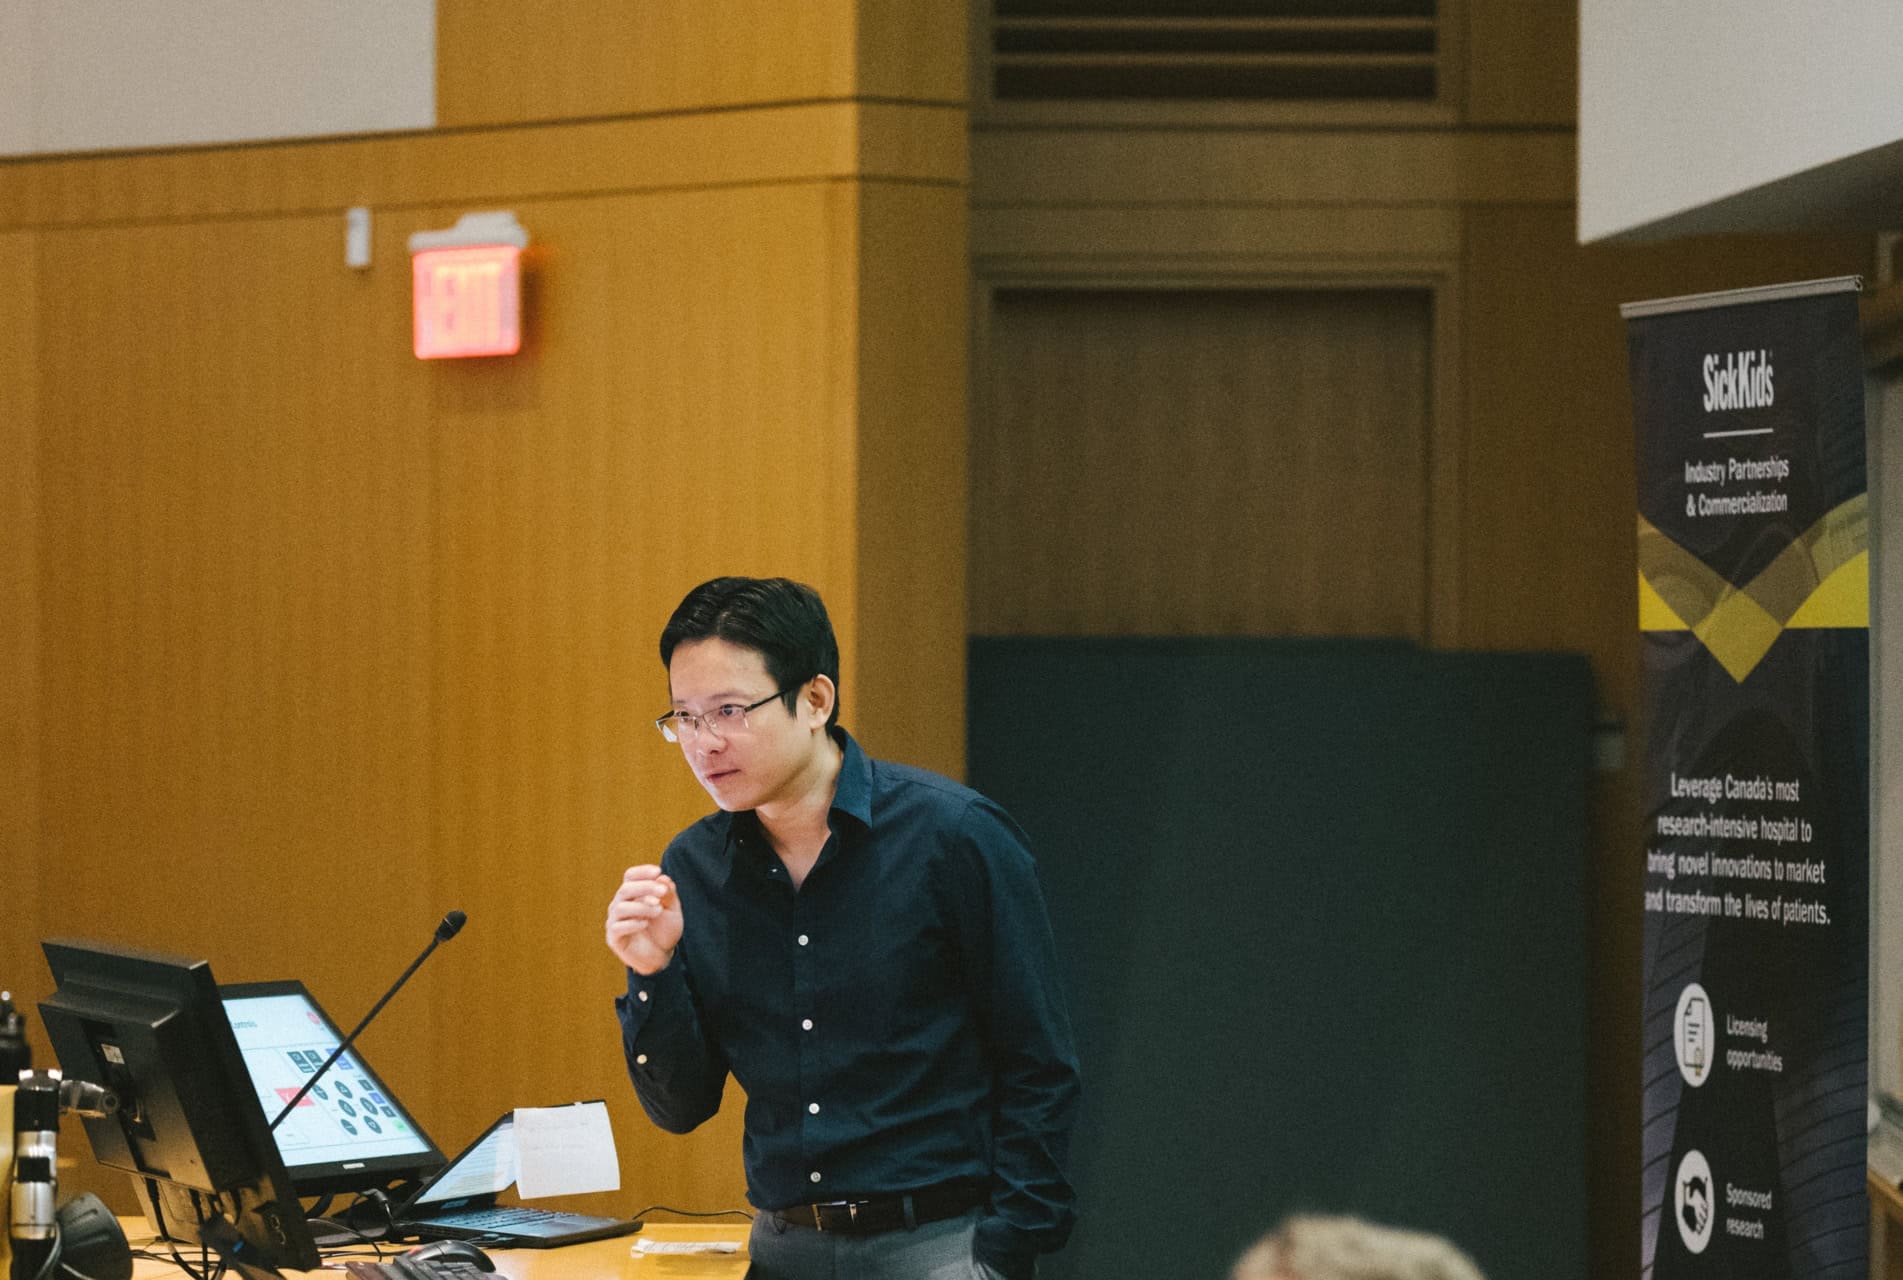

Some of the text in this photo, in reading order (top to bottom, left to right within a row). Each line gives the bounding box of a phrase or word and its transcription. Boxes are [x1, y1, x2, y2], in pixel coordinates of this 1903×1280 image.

[1703, 349, 1774, 413] SickKids
[1685, 455, 1790, 487] Industry Partnerships
[1686, 490, 1788, 517] & Commercialization
[1671, 772, 1800, 805] Leverage Canada's most
[1657, 813, 1812, 846] research-intensive hospital to
[1647, 849, 1826, 884] bring novel innovations to market
[1645, 887, 1831, 928] and transform the lives of patients.
[1726, 1014, 1768, 1043] Licensing
[1726, 1049, 1783, 1073] opportunities
[1726, 1182, 1772, 1211] Sponsored
[1726, 1217, 1764, 1240] research
